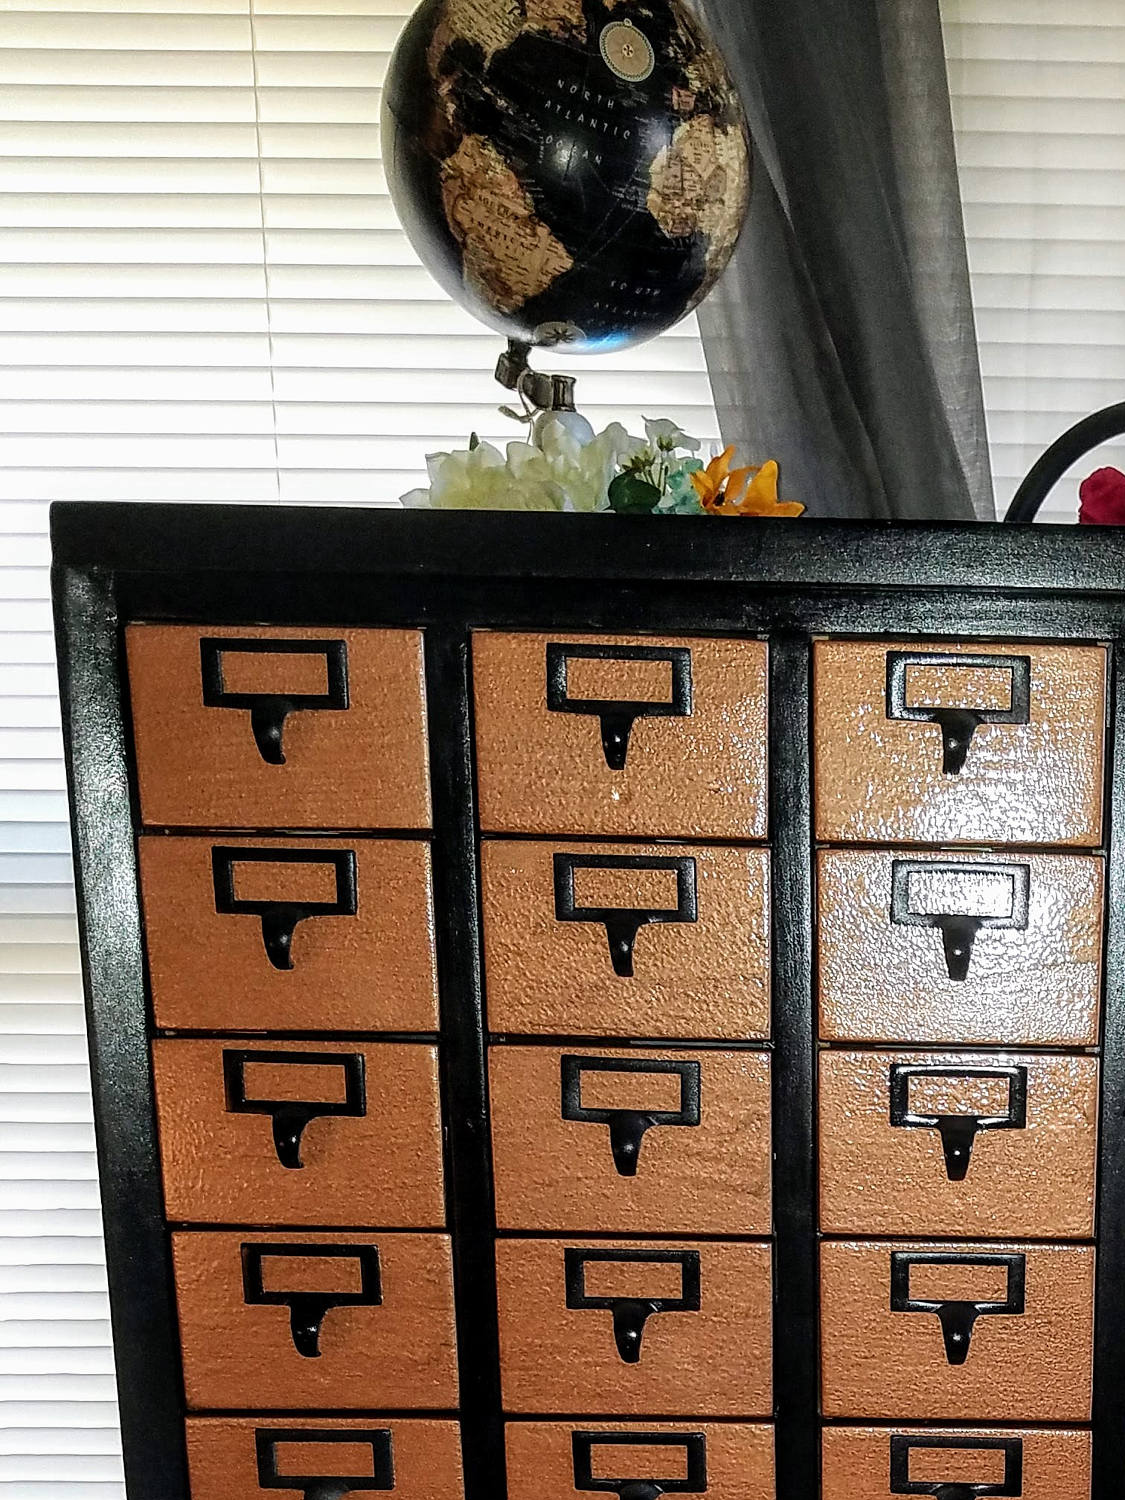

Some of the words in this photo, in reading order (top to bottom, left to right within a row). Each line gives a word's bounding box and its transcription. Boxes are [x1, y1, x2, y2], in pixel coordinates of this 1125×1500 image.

[557, 79, 615, 110] NORTH
[544, 100, 631, 139] ATLANTIC
[545, 135, 603, 164] OCEAN
